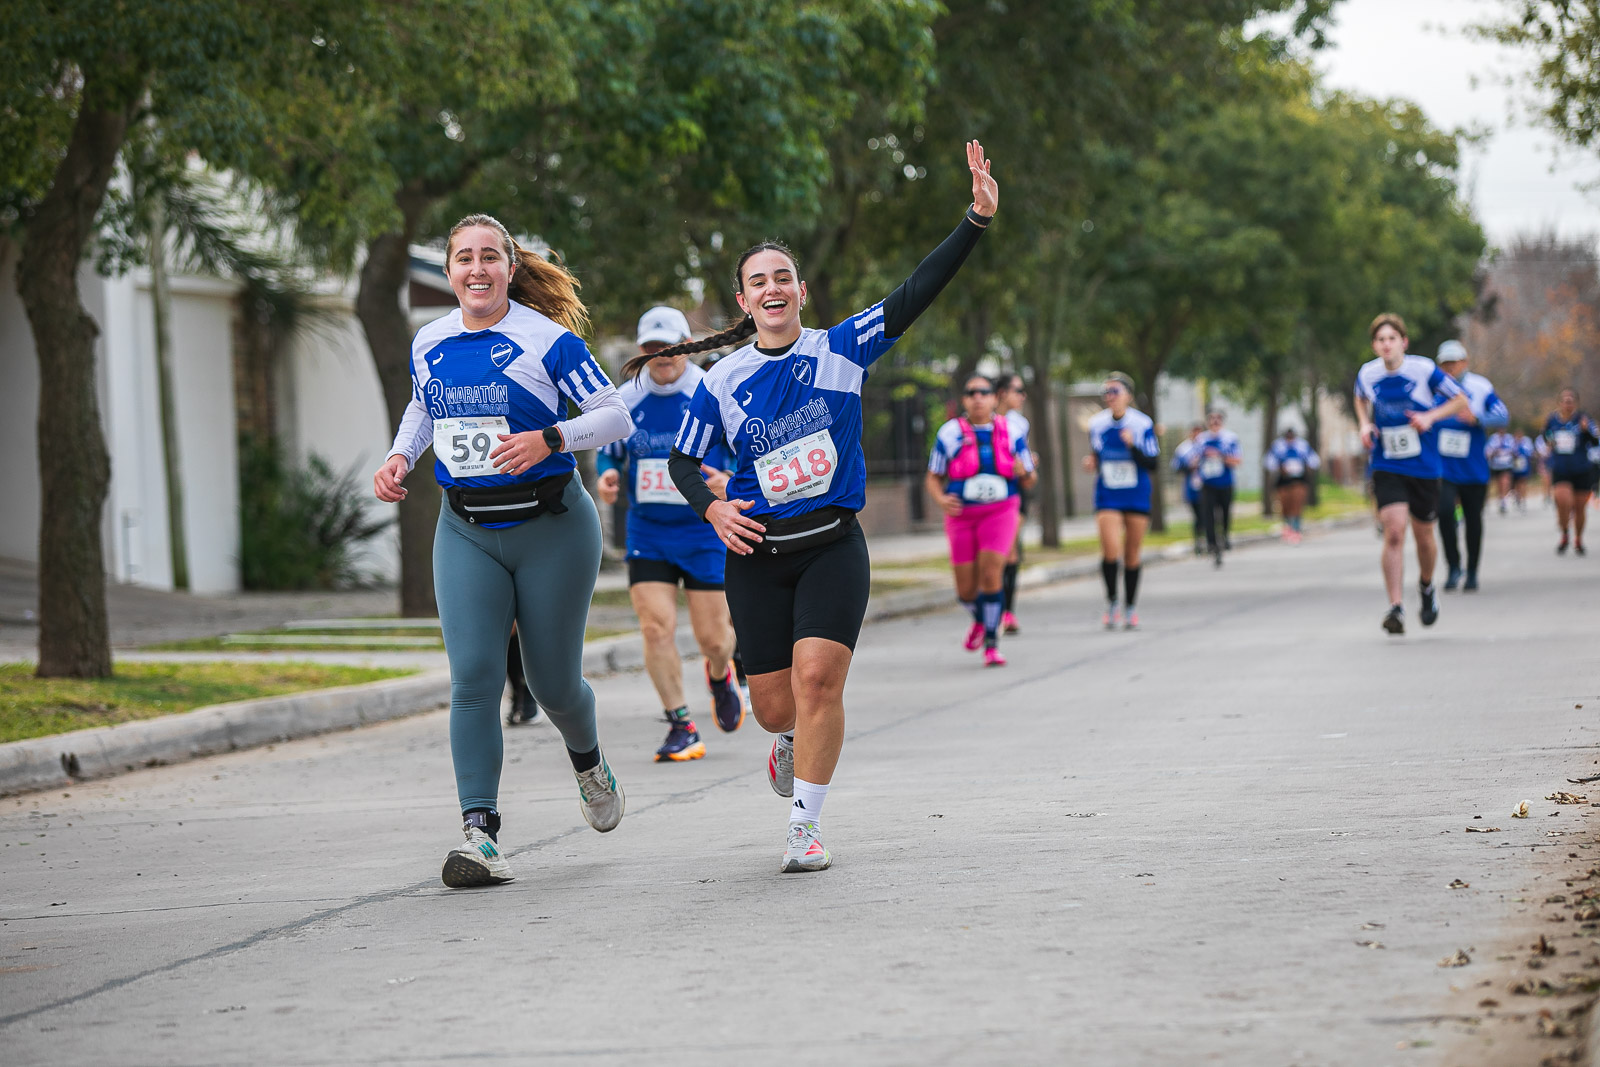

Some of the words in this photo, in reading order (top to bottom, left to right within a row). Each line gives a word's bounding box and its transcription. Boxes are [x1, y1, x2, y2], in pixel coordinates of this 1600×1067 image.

[428, 378, 448, 420] 3
[446, 382, 508, 404] MARATÓN
[746, 417, 771, 457] 3
[768, 397, 829, 440] MARATÓN
[451, 433, 490, 462] 59
[641, 470, 678, 491] 51
[768, 449, 831, 492] 518
